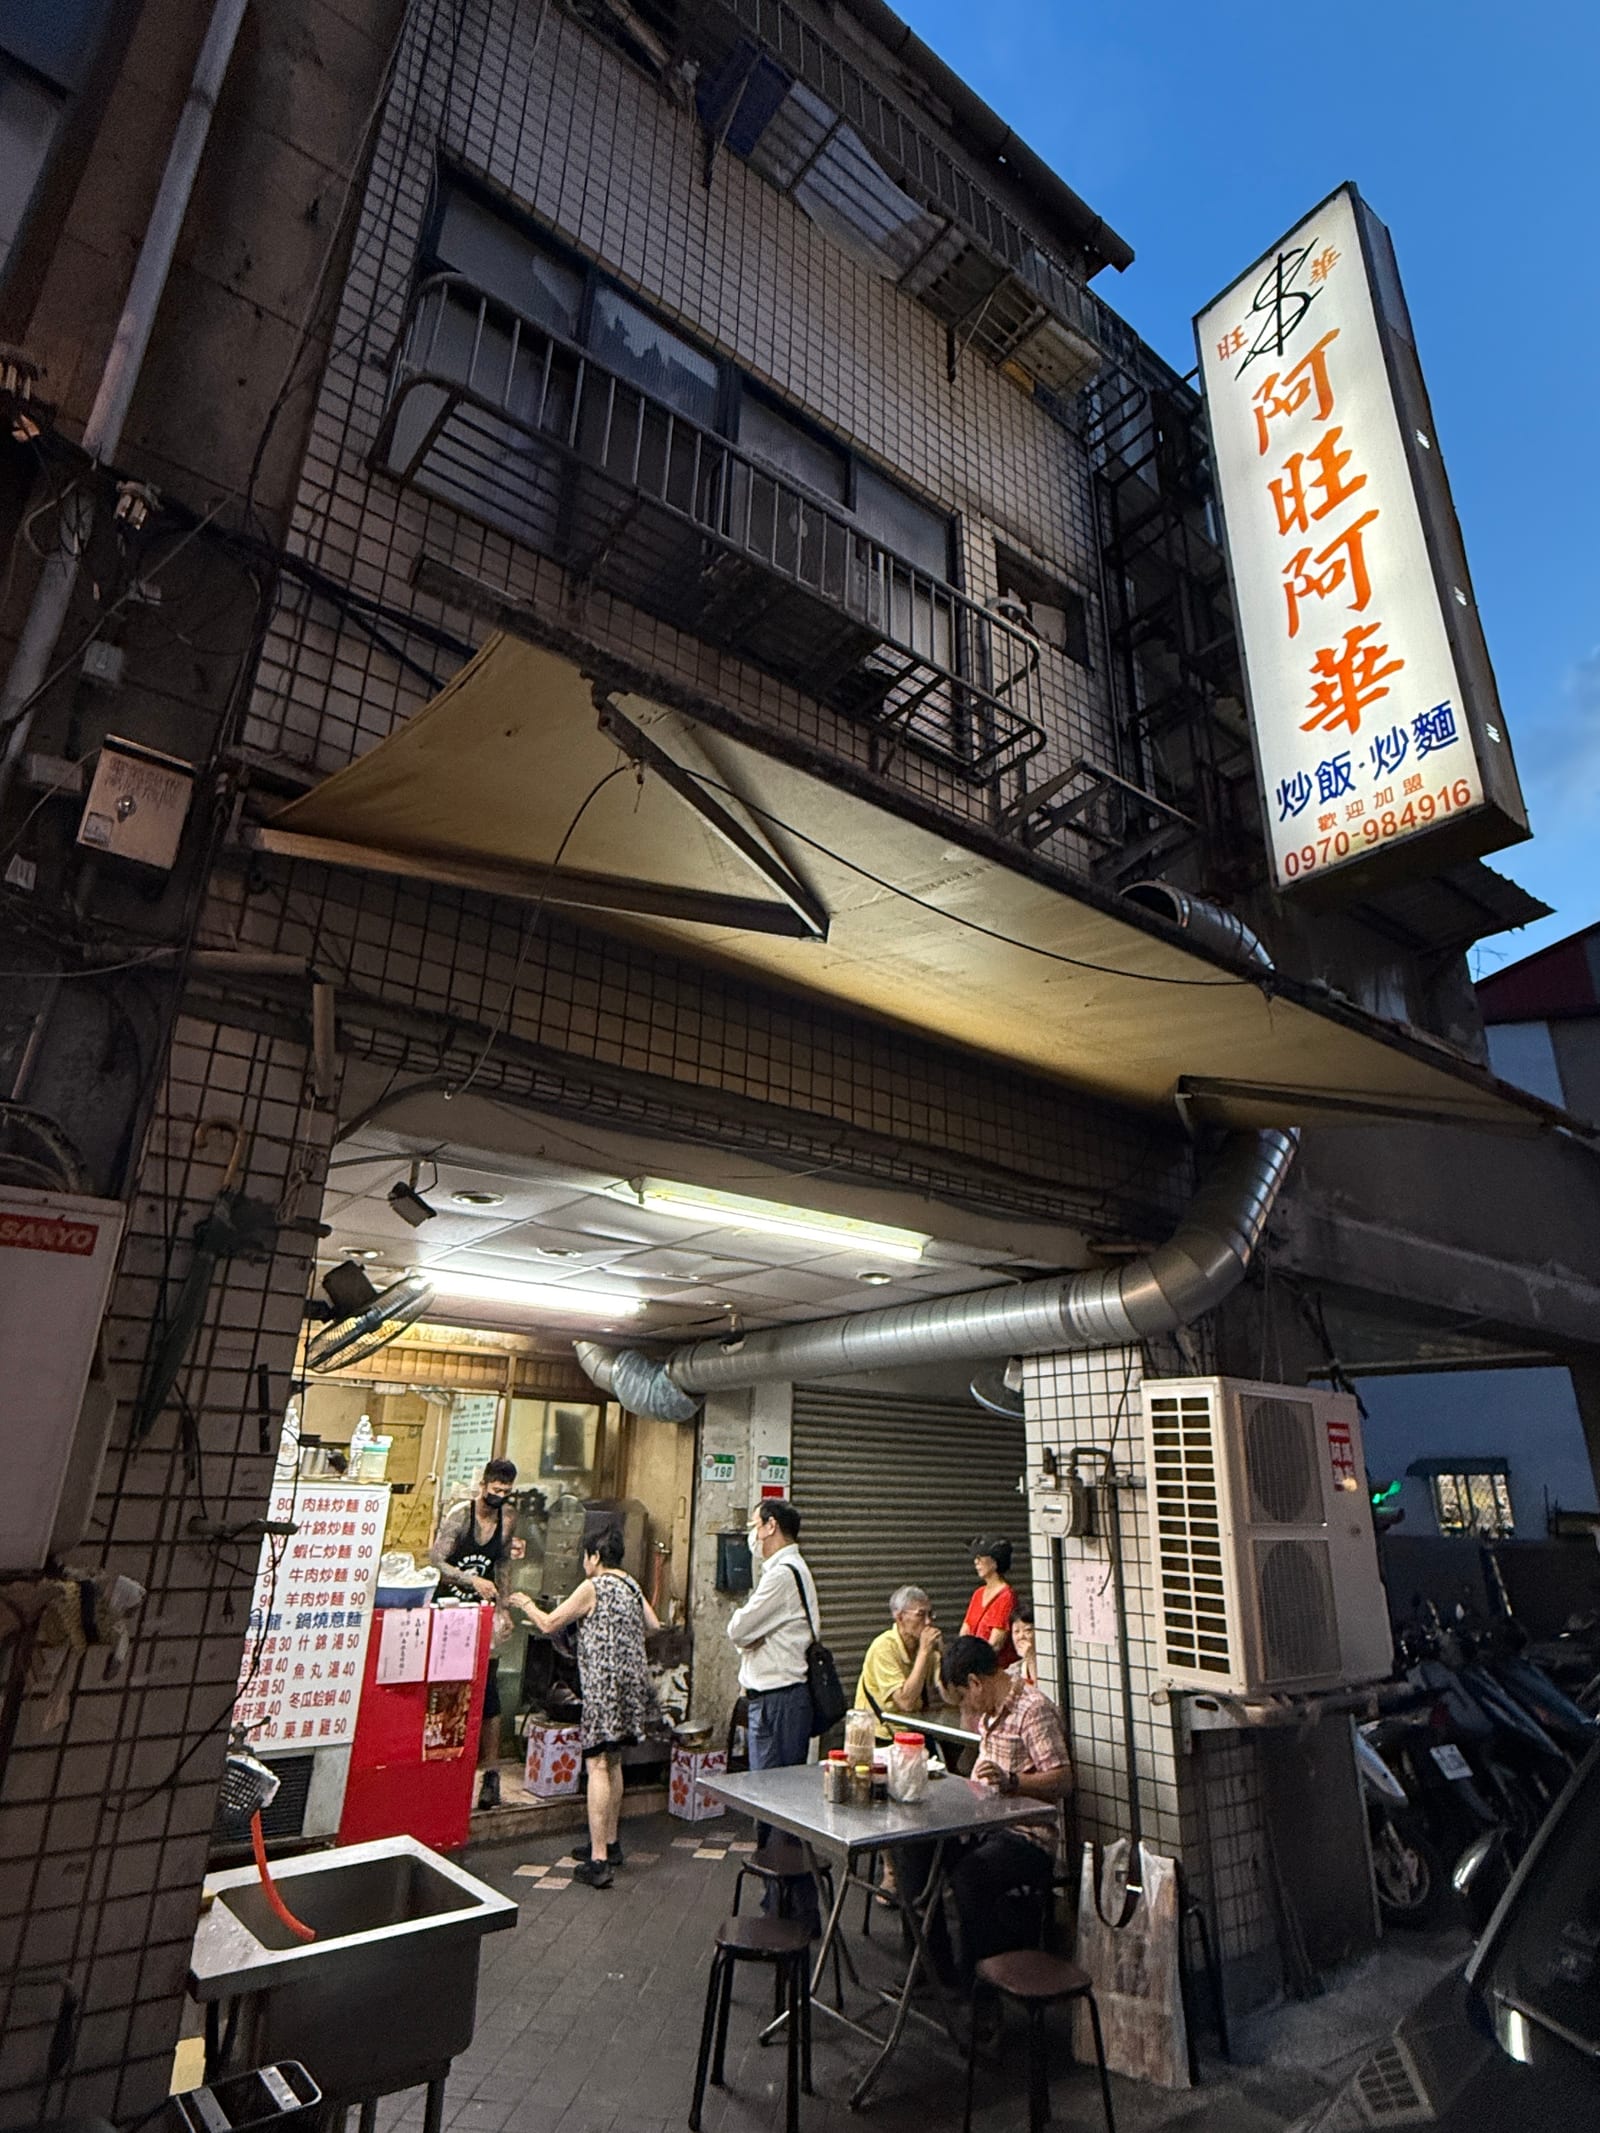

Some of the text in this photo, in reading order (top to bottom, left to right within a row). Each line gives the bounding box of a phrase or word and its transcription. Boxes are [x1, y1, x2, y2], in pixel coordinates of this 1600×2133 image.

[1216, 325, 1249, 361] 旺
[1251, 327, 1405, 735] 阿旺阿華
[1317, 773, 1424, 832] 歡迎加盟
[1285, 778, 1471, 877] 0970-984916
[0, 1219, 94, 1249] SANYO
[714, 1466, 733, 1478] 190
[768, 1467, 786, 1479] 192
[302, 1497, 379, 1513] 肉絲炒麵 80
[298, 1520, 376, 1536] 什錦炒麵 90
[292, 1543, 372, 1559] 蝦仁炒麵 90
[288, 1567, 369, 1583] 牛肉炒麵 90
[284, 1591, 366, 1607] 羊肉炒麵 90
[279, 1636, 292, 1651] 30
[298, 1633, 360, 1651] 什錦湯 50
[275, 1657, 288, 1673] 40
[292, 1661, 340, 1679] 魚丸湯
[342, 1661, 355, 1677] 40
[271, 1679, 285, 1694] 50
[338, 1689, 352, 1704] 40
[268, 1700, 282, 1716] 40
[264, 1721, 278, 1738] 40
[334, 1718, 347, 1734] 50
